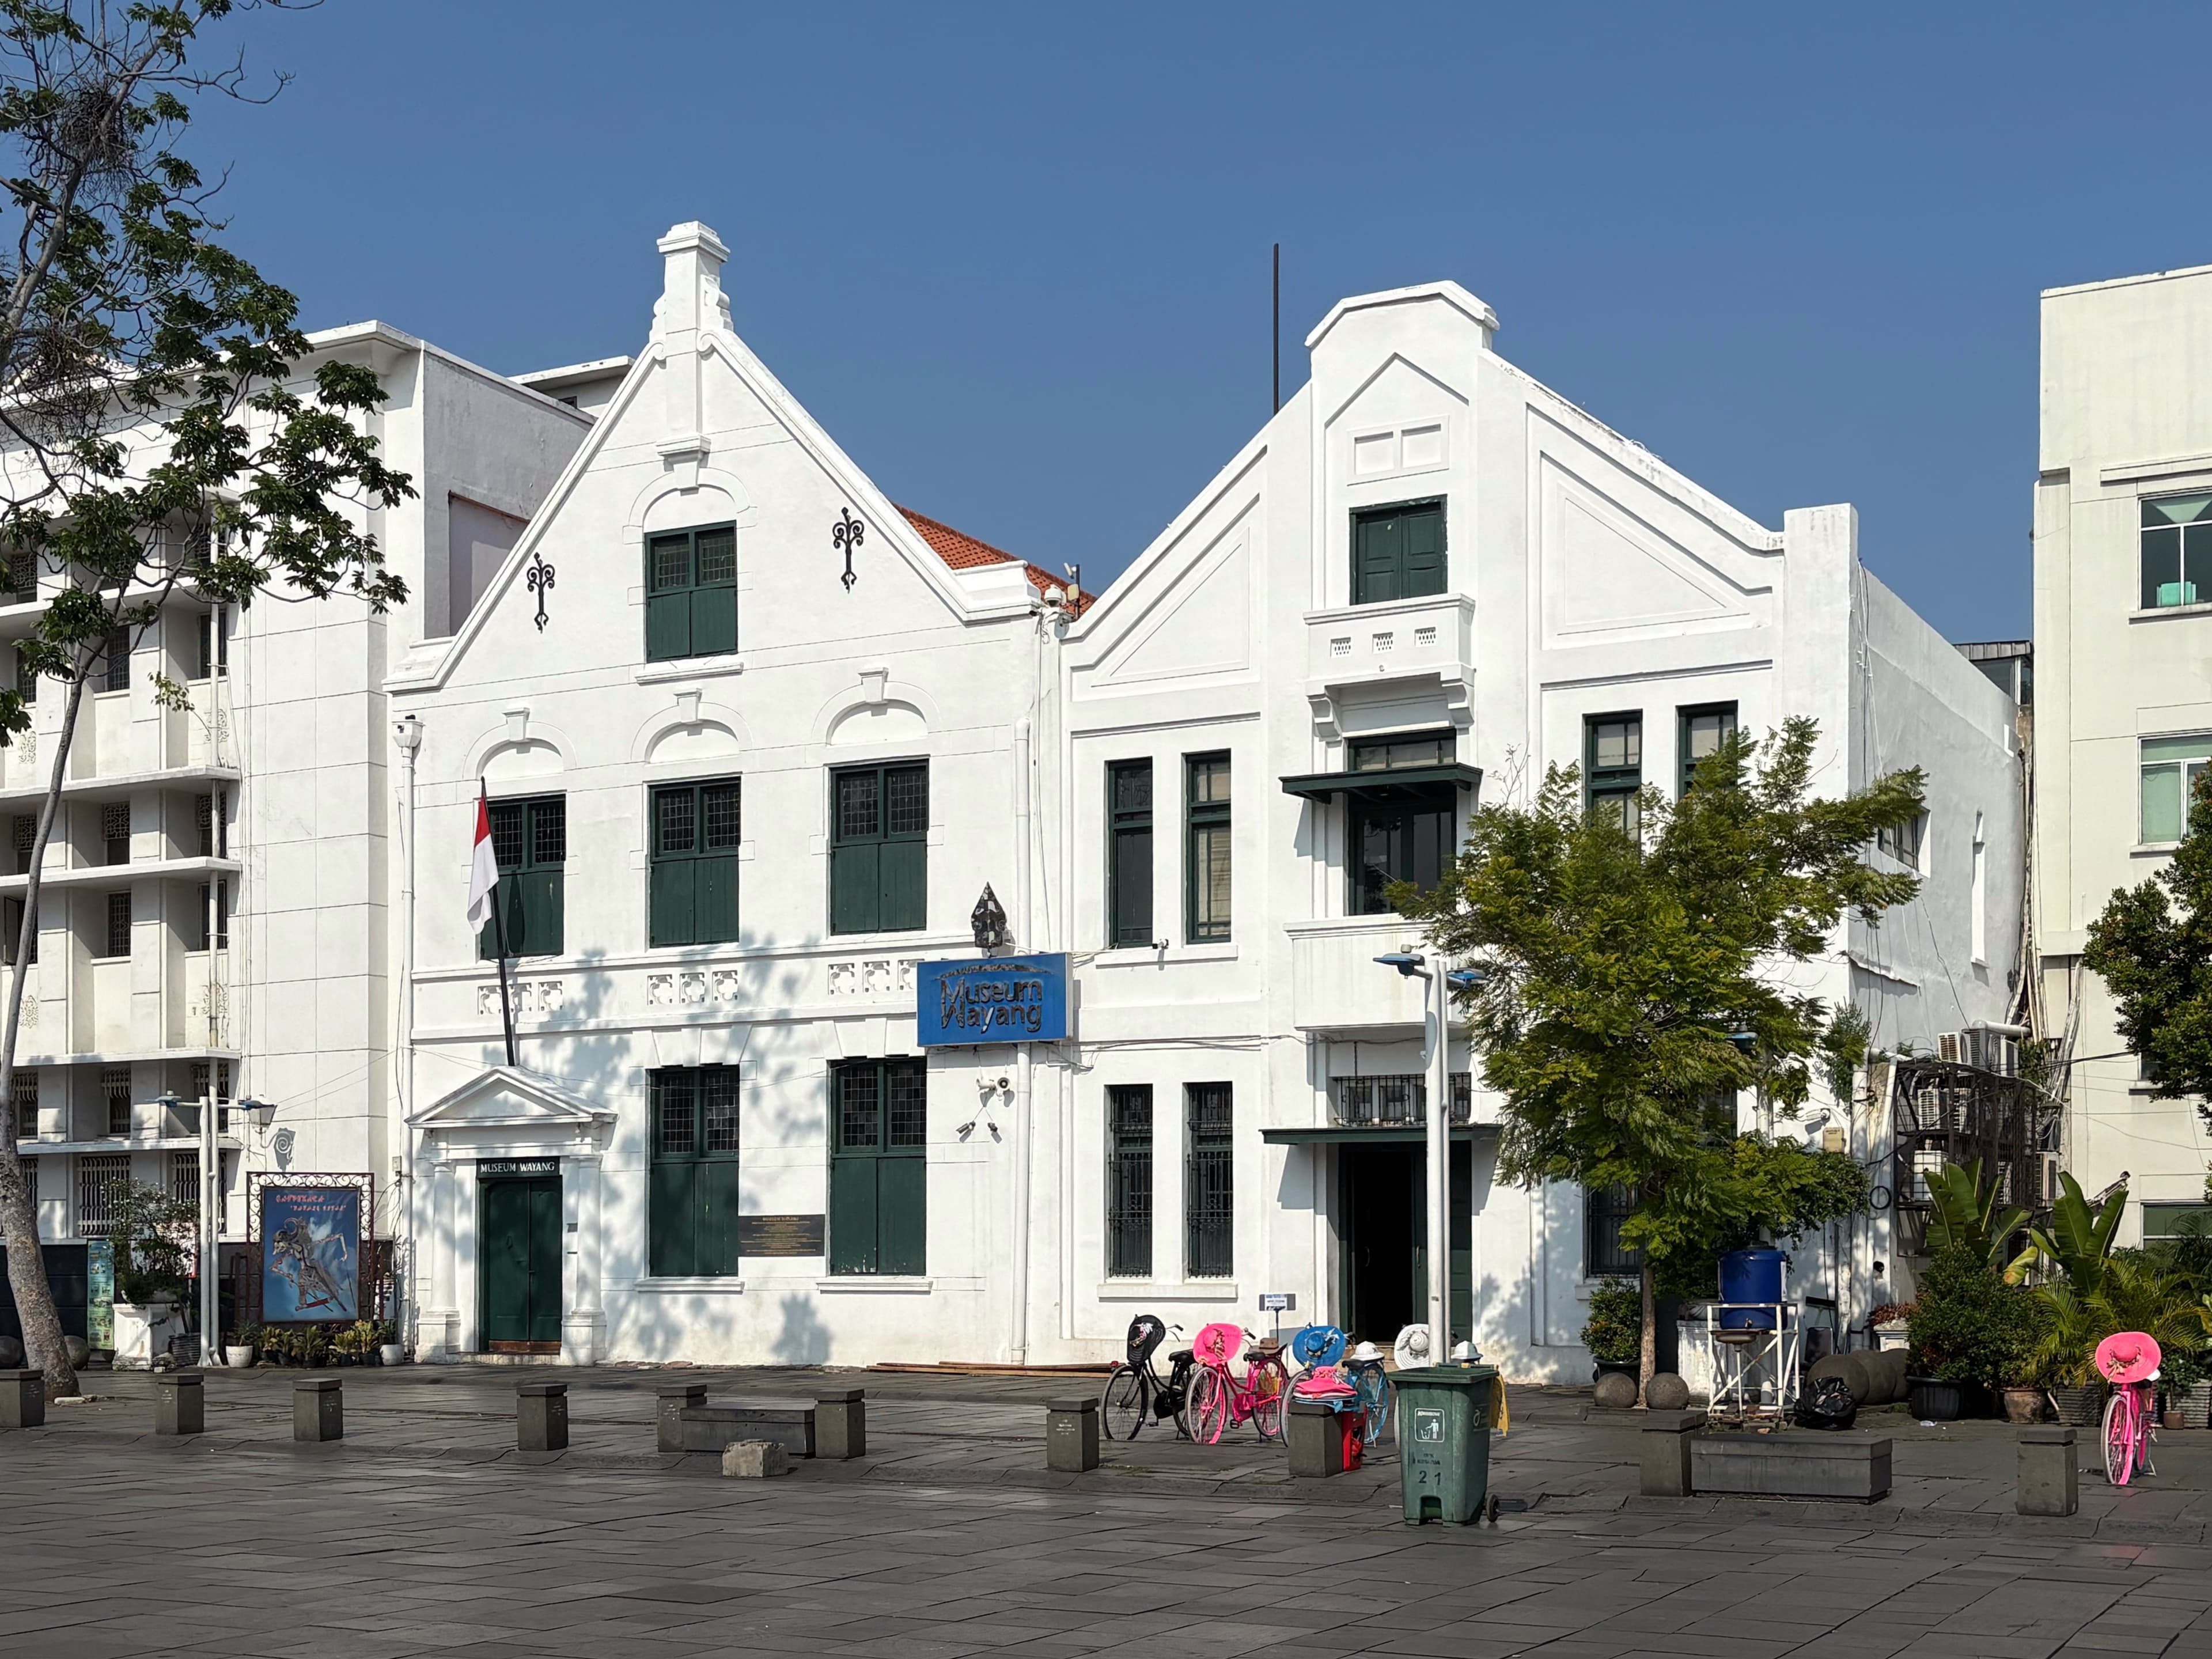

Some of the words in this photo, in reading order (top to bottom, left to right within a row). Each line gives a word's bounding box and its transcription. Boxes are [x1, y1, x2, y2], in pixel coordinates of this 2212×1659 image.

[941, 977, 1043, 1004] Museum
[941, 1004, 1042, 1033] Wayang
[480, 1162, 516, 1173] MUSEUM
[520, 1161, 555, 1172] WAYANG
